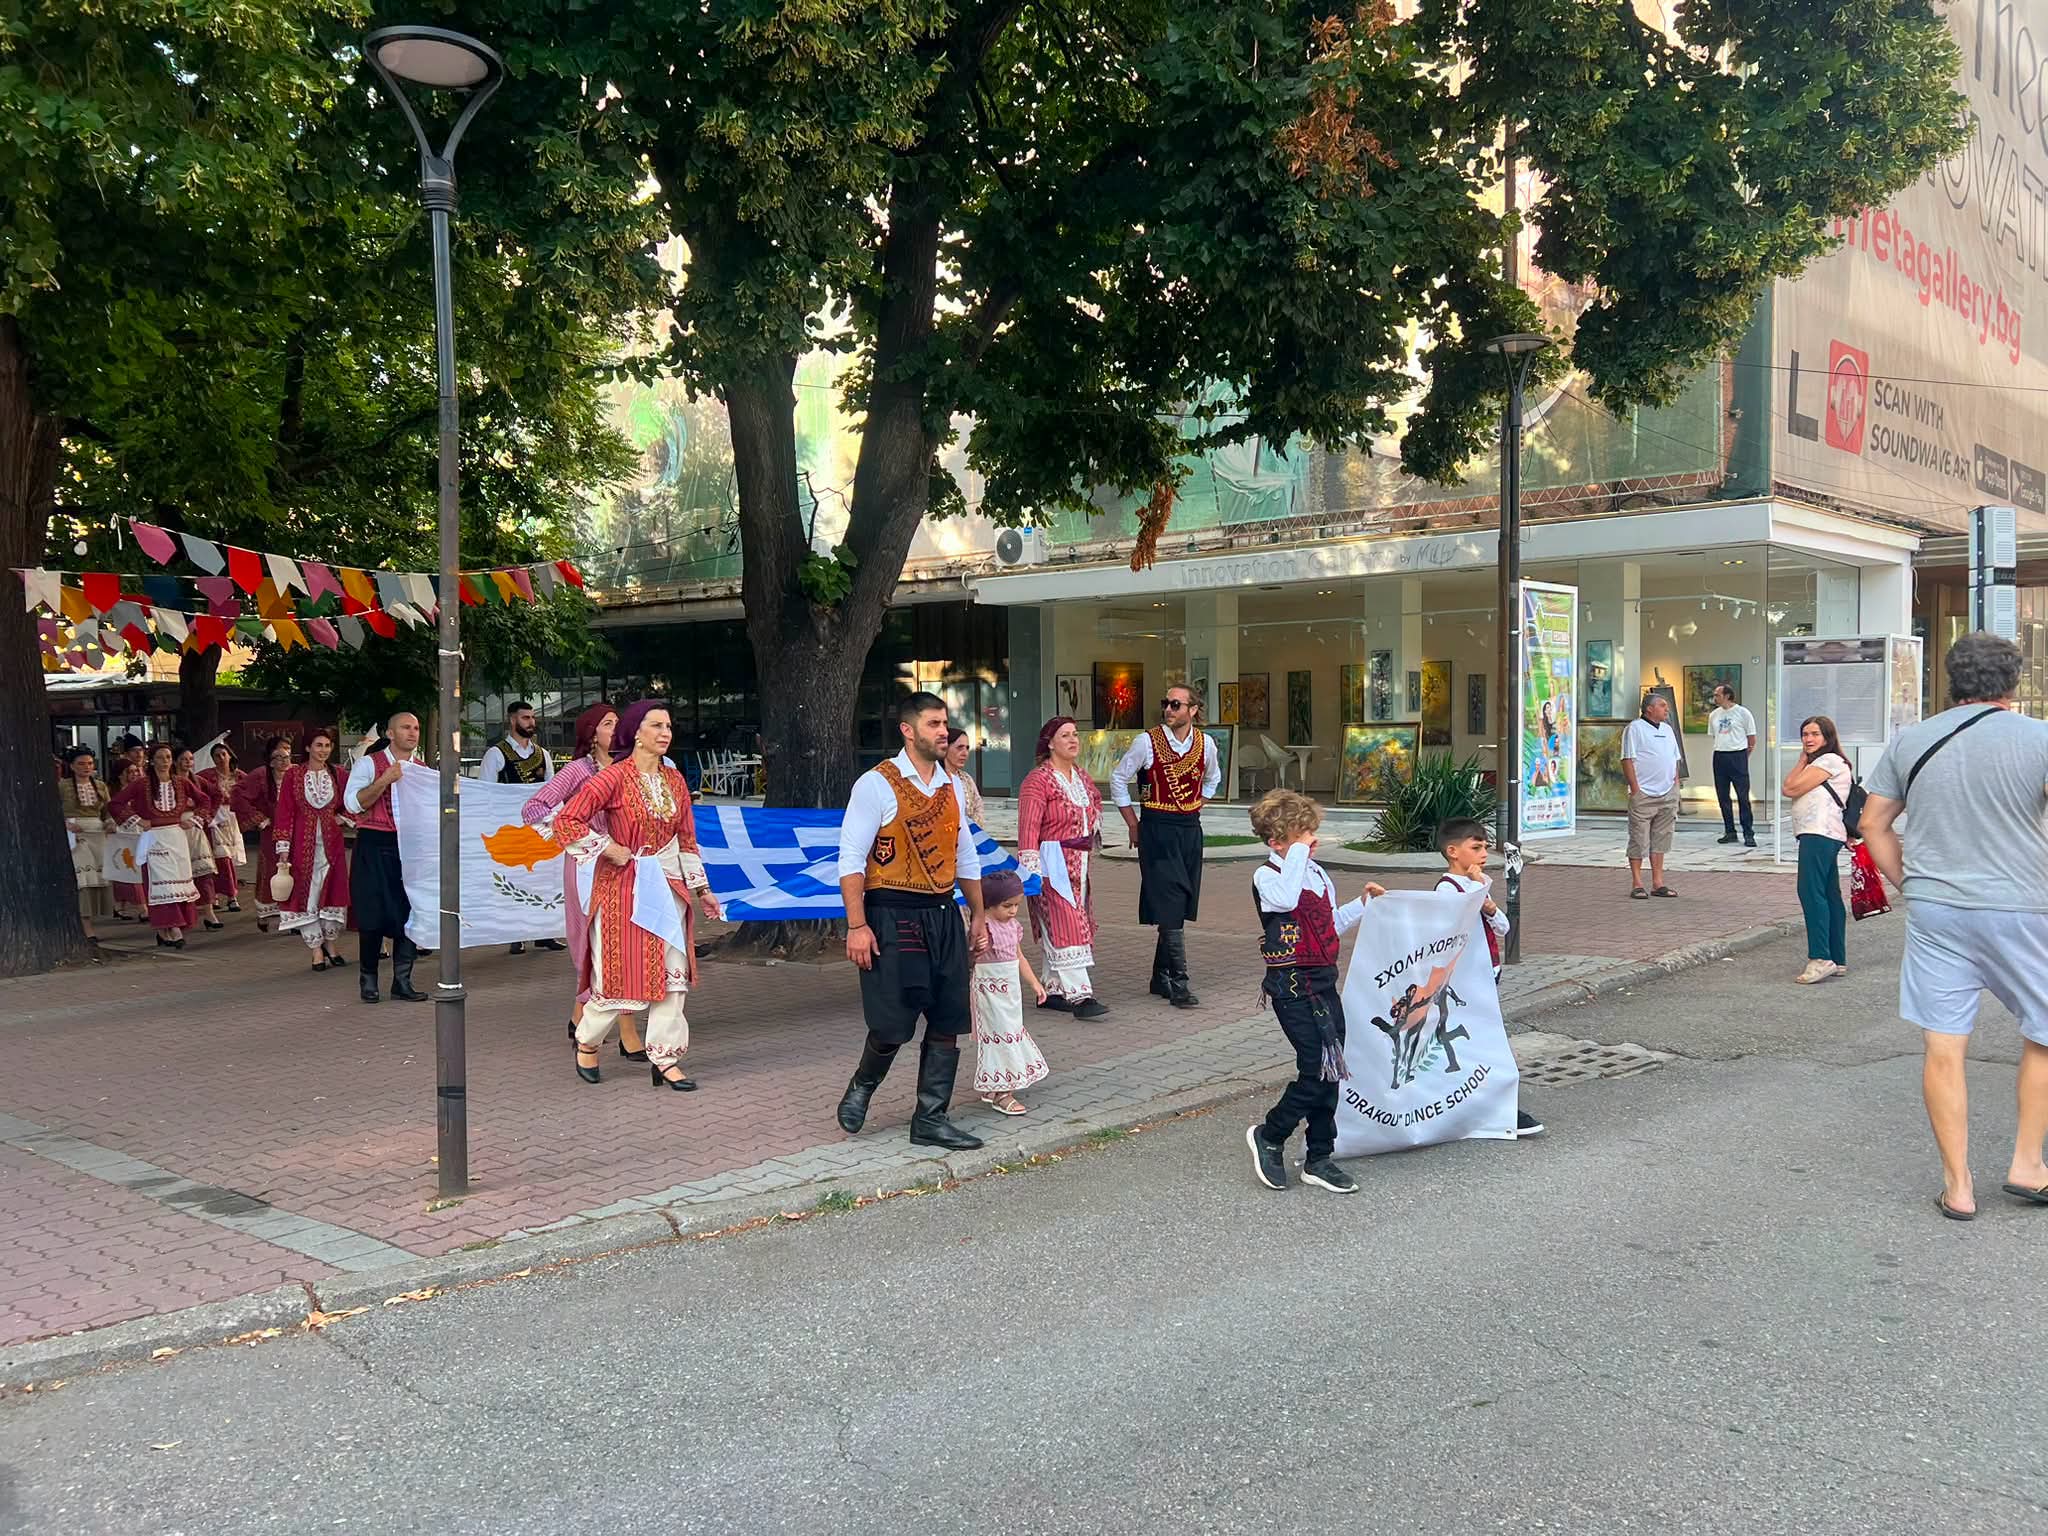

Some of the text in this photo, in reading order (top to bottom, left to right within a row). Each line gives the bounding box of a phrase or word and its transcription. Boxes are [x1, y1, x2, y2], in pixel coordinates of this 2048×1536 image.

[1874, 379, 1944, 431] SCAN WITH
[1870, 424, 1951, 476] SOUNDWAVE
[1953, 454, 1970, 481] ART
[1400, 554, 1411, 564] by
[1374, 947, 1424, 988] ΣΧΟΛΗ
[1405, 1101, 1444, 1127] DANCE
[1446, 1064, 1491, 1109] SCHOOL
